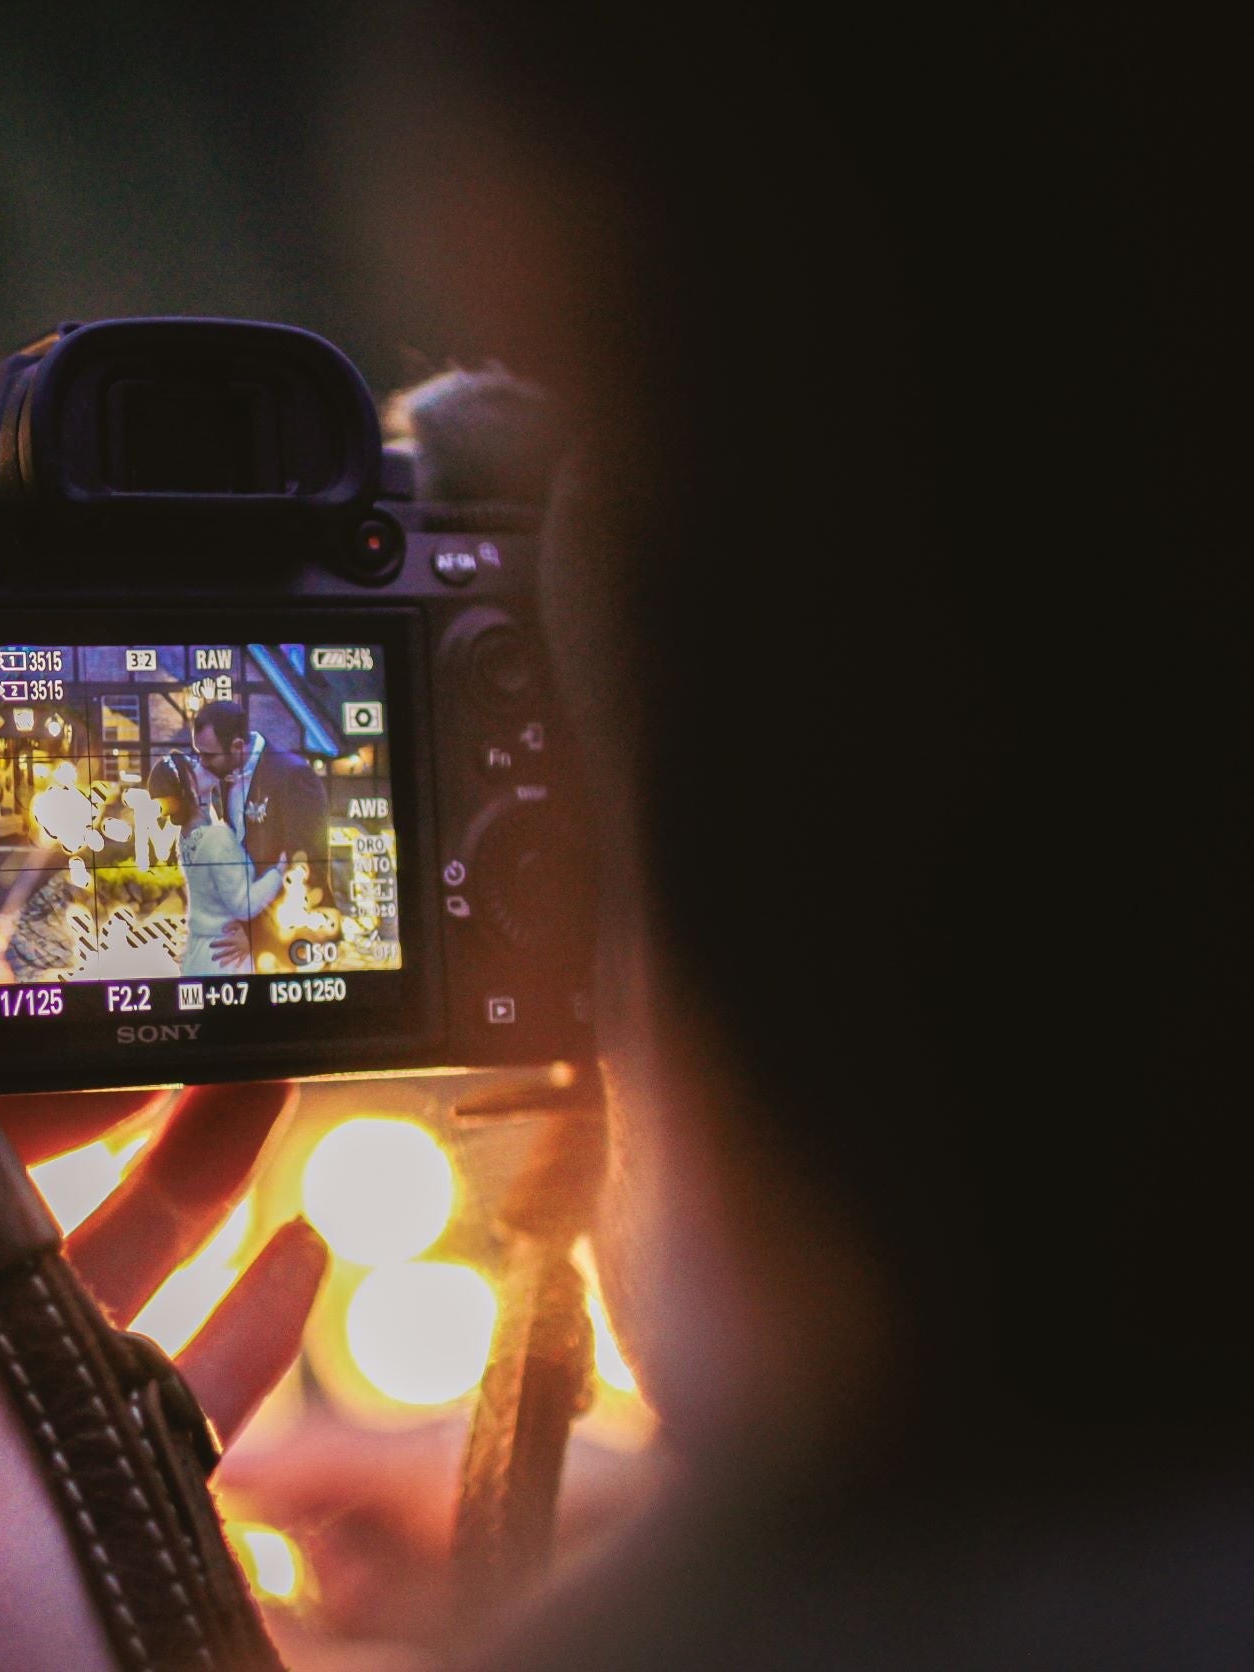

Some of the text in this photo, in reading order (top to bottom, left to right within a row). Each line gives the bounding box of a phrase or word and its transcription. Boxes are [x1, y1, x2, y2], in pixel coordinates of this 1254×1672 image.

[28, 651, 63, 672] 3515
[196, 649, 232, 670] RAW
[30, 680, 64, 701] 3515
[349, 798, 389, 819] AWB
[356, 838, 384, 852] DRO
[305, 942, 338, 963] ISO
[0, 989, 64, 1017] 1/125
[107, 985, 152, 1012] F2.2
[205, 982, 249, 1006] +0.7
[116, 1024, 202, 1044] SONY
